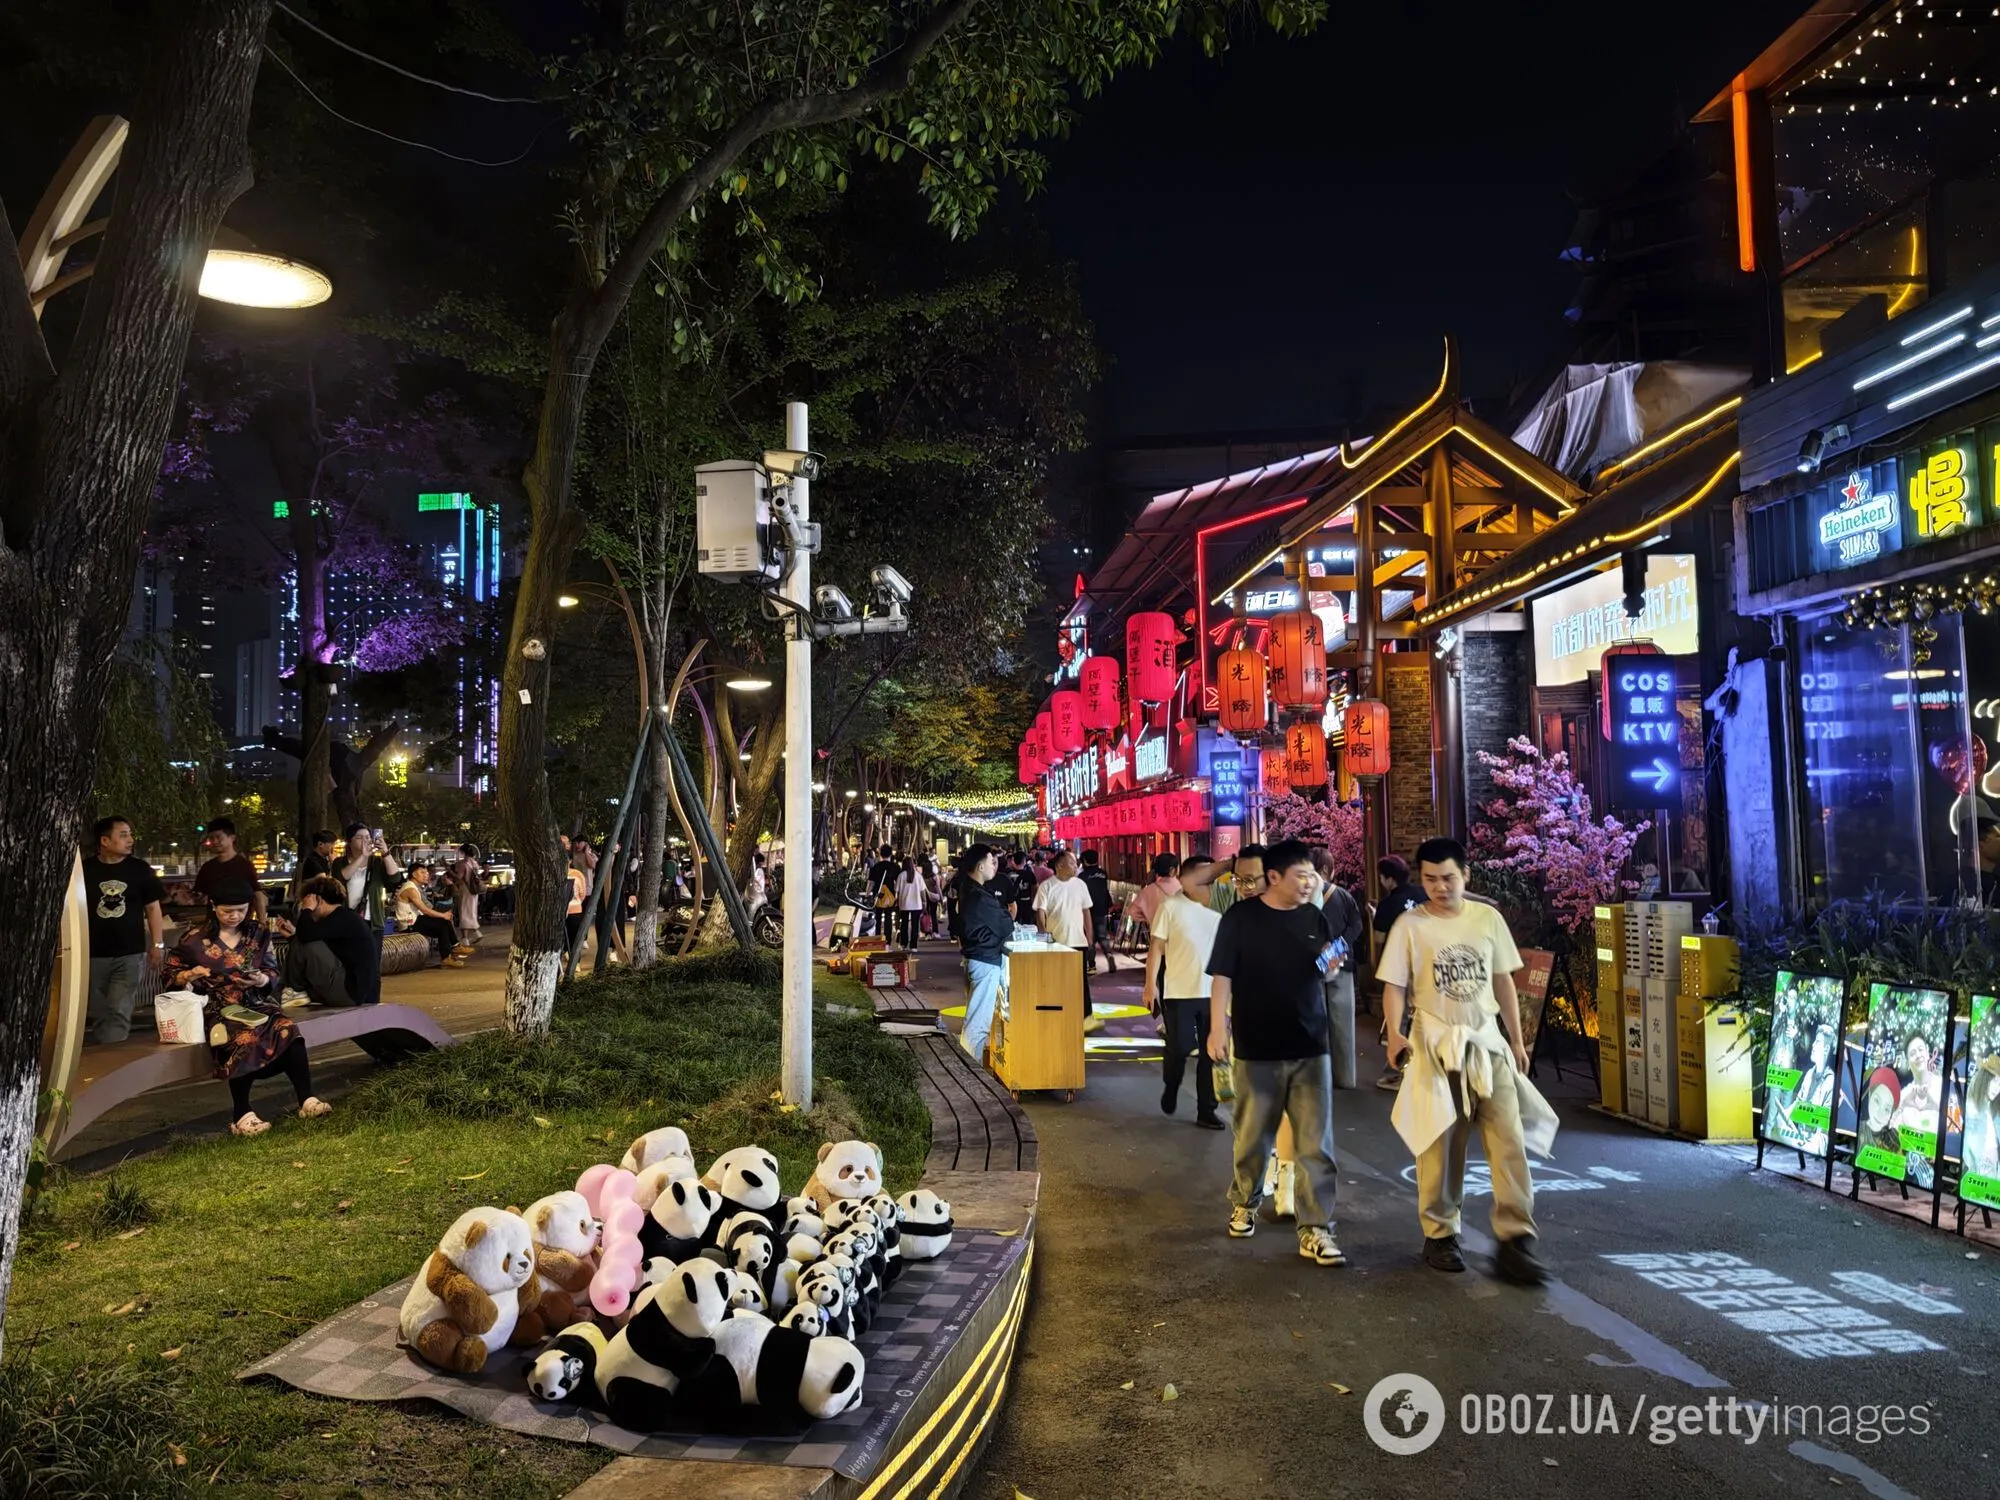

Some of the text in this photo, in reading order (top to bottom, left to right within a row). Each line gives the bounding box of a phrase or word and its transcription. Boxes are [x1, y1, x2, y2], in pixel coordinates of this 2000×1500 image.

[1824, 504, 1887, 538] Heineken
[1840, 532, 1876, 560] SILVER
[1552, 576, 1690, 660] 成都的柔时光
[1154, 639, 1175, 669] 酒
[1621, 673, 1669, 692] COS
[1623, 723, 1672, 741] KTV
[1214, 760, 1239, 770] COS
[1215, 783, 1241, 795] KTV
[846, 1450, 870, 1476] Happy
[864, 1434, 878, 1451] and
